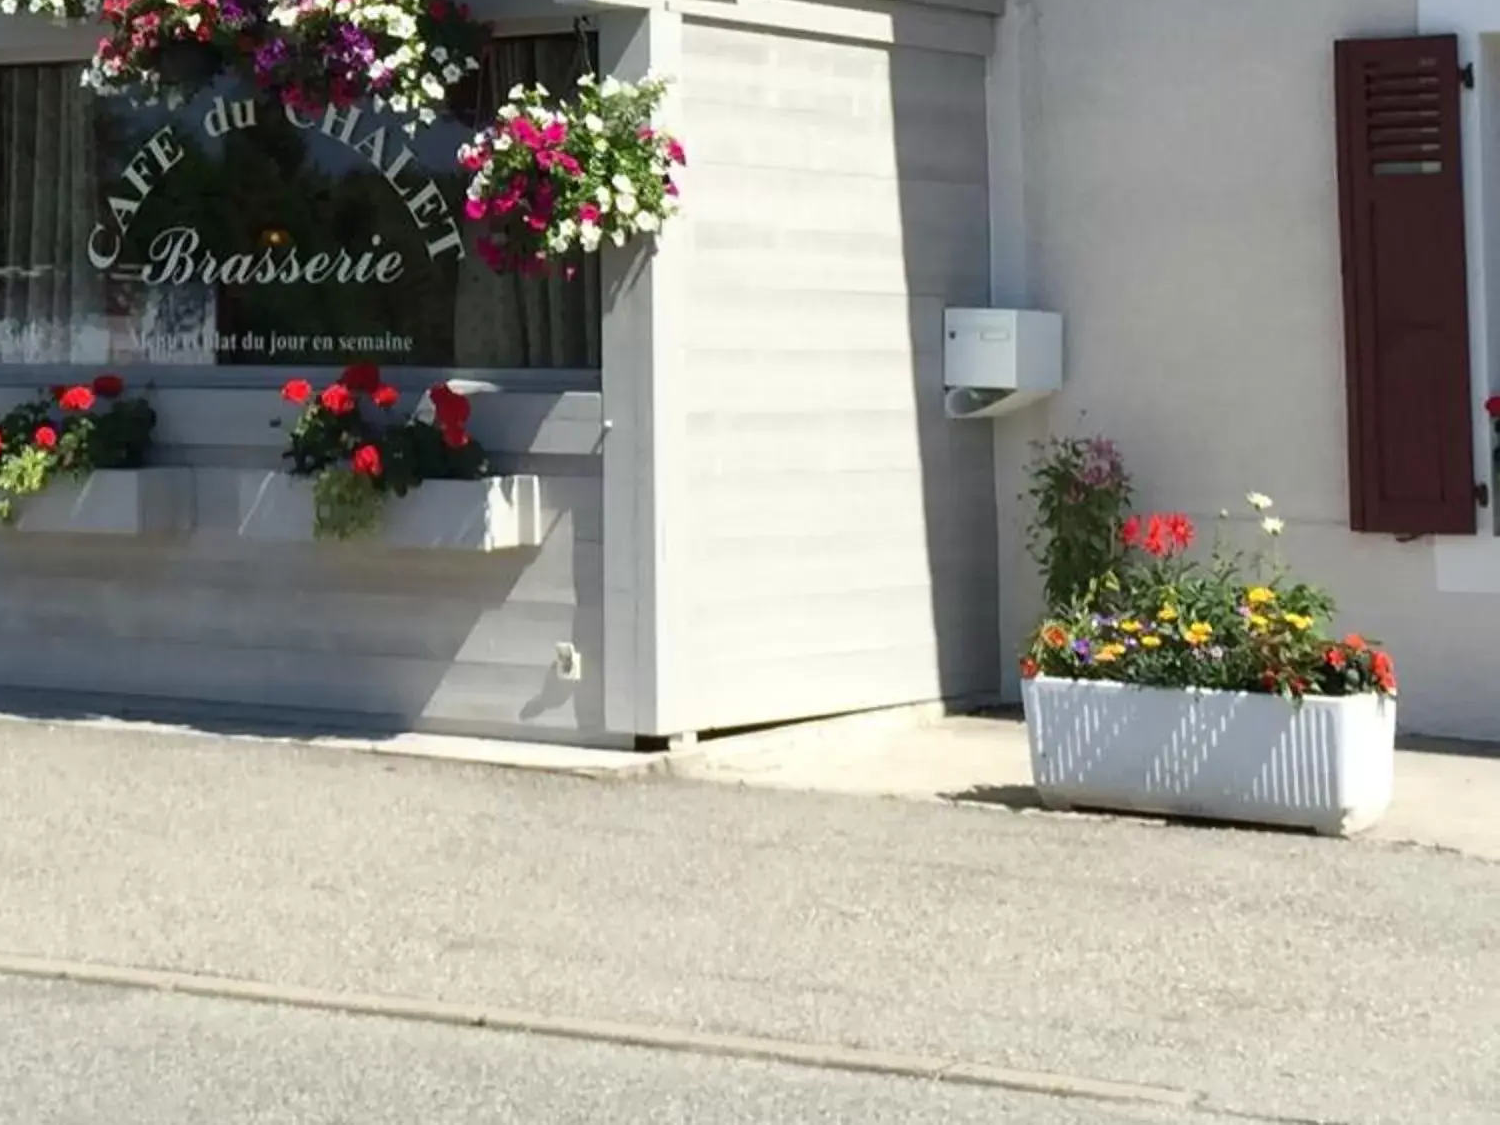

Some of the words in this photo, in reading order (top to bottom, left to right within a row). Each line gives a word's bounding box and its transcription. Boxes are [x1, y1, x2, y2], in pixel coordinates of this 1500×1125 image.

[87, 125, 186, 269] CAFE
[203, 94, 257, 138] du
[285, 101, 466, 263] CHALET
[141, 226, 405, 286] Brasserie
[241, 329, 265, 351] du
[269, 328, 309, 356] jour
[312, 334, 334, 351] en
[339, 330, 414, 352] semaine
